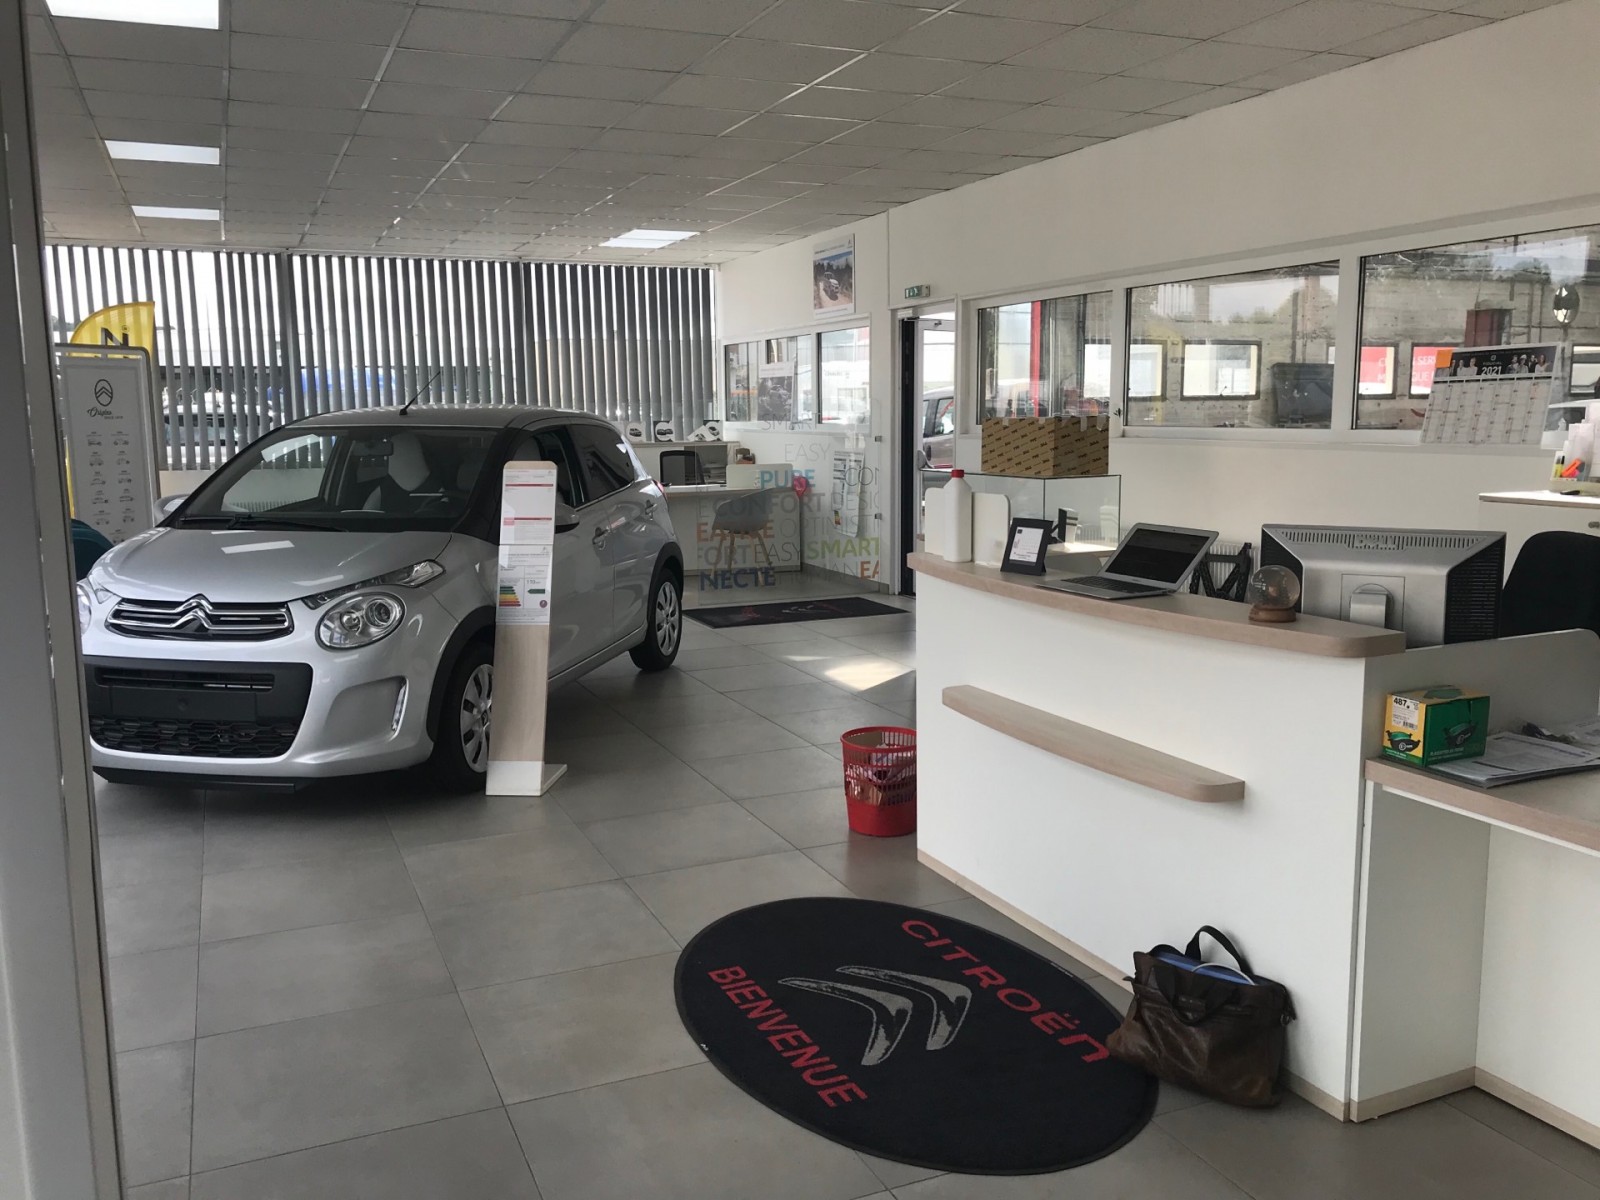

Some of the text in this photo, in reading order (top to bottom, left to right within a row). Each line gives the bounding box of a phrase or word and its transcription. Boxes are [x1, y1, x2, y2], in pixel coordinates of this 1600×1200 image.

[1481, 366, 1502, 376] 2021
[784, 442, 831, 463] EASY
[754, 540, 801, 565] EASY
[806, 537, 880, 561] SMART
[707, 964, 869, 1109] BIENVENUE
